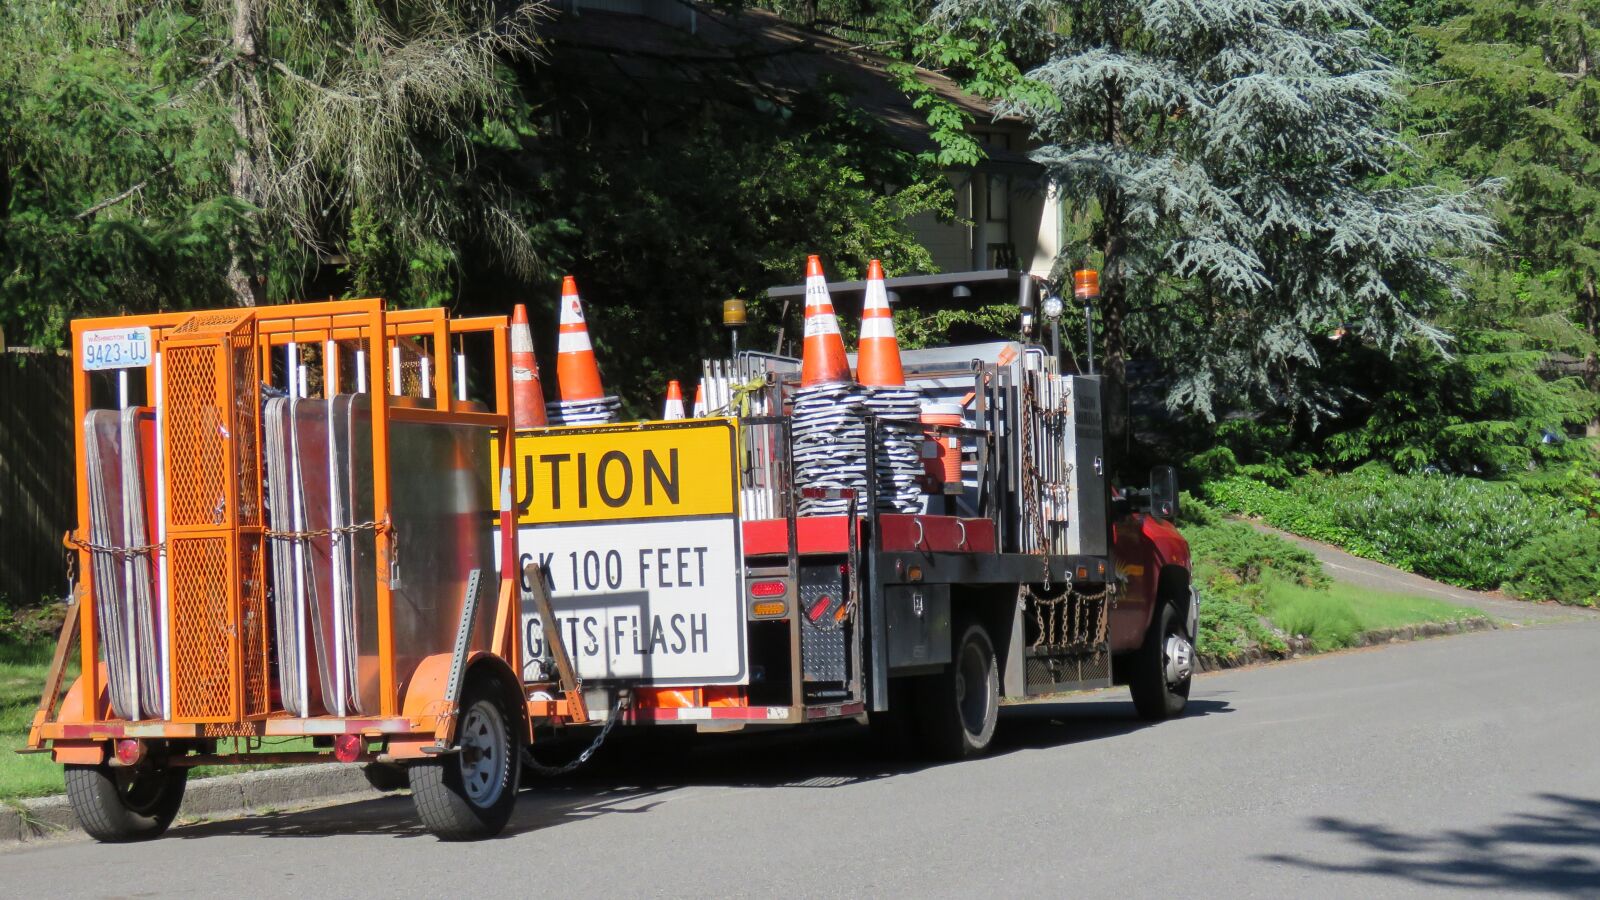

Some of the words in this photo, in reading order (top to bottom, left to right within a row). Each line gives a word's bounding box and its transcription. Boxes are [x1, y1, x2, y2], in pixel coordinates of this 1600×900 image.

[569, 549, 622, 591] 100
[639, 546, 708, 589] FEET
[526, 615, 599, 659] GTS
[613, 612, 708, 656] FLASH
